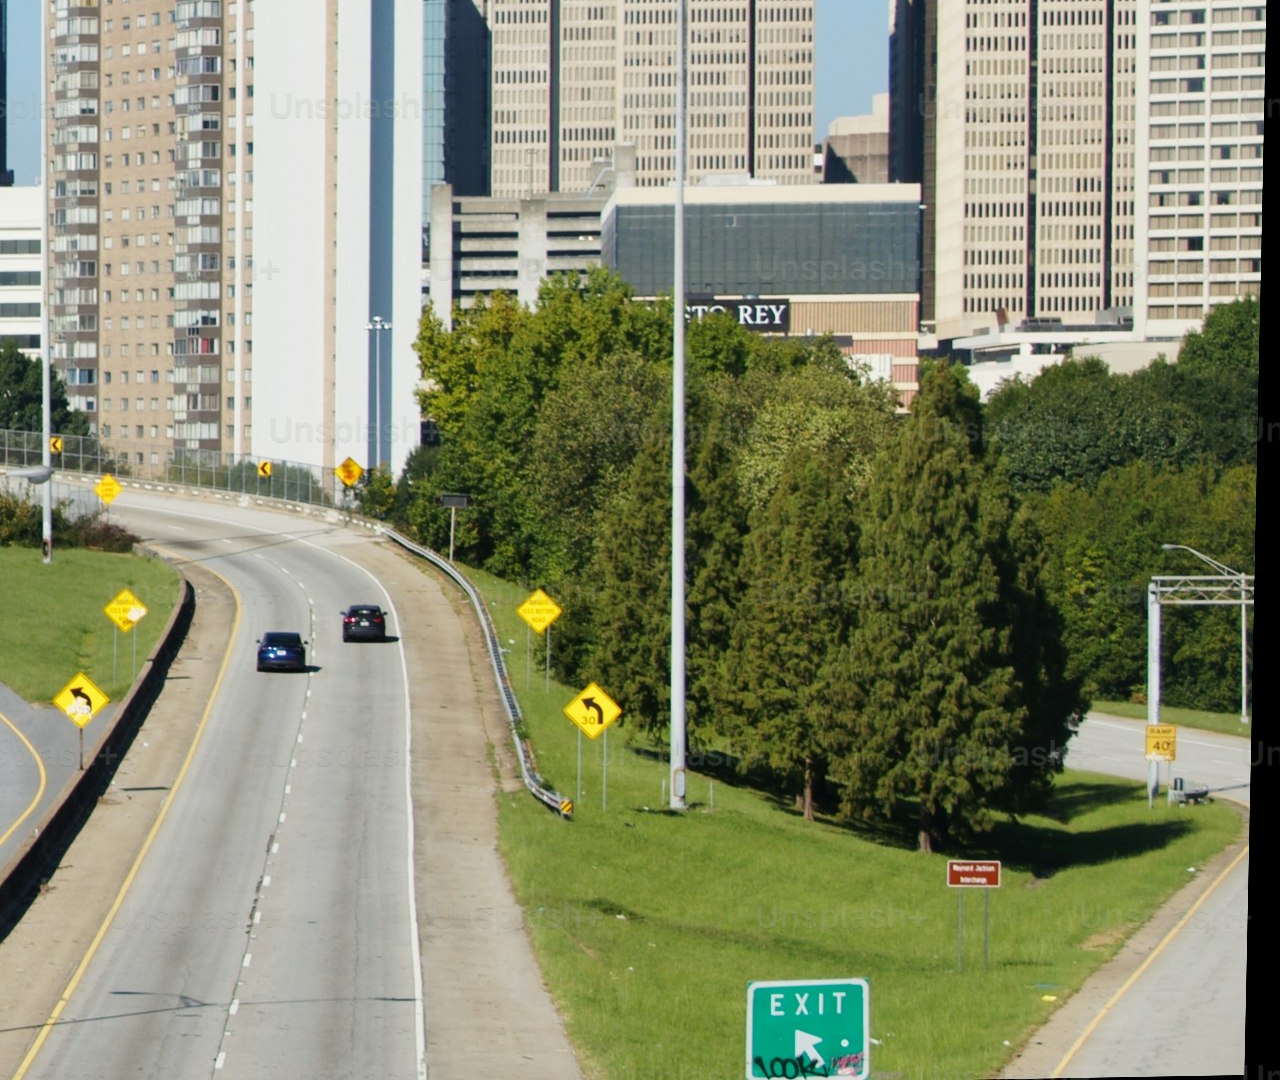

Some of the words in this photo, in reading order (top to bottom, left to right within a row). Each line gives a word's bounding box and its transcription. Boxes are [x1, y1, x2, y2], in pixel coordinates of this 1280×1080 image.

[738, 304, 786, 325] REY
[581, 716, 596, 725] 30
[771, 991, 846, 1016] EXIT
